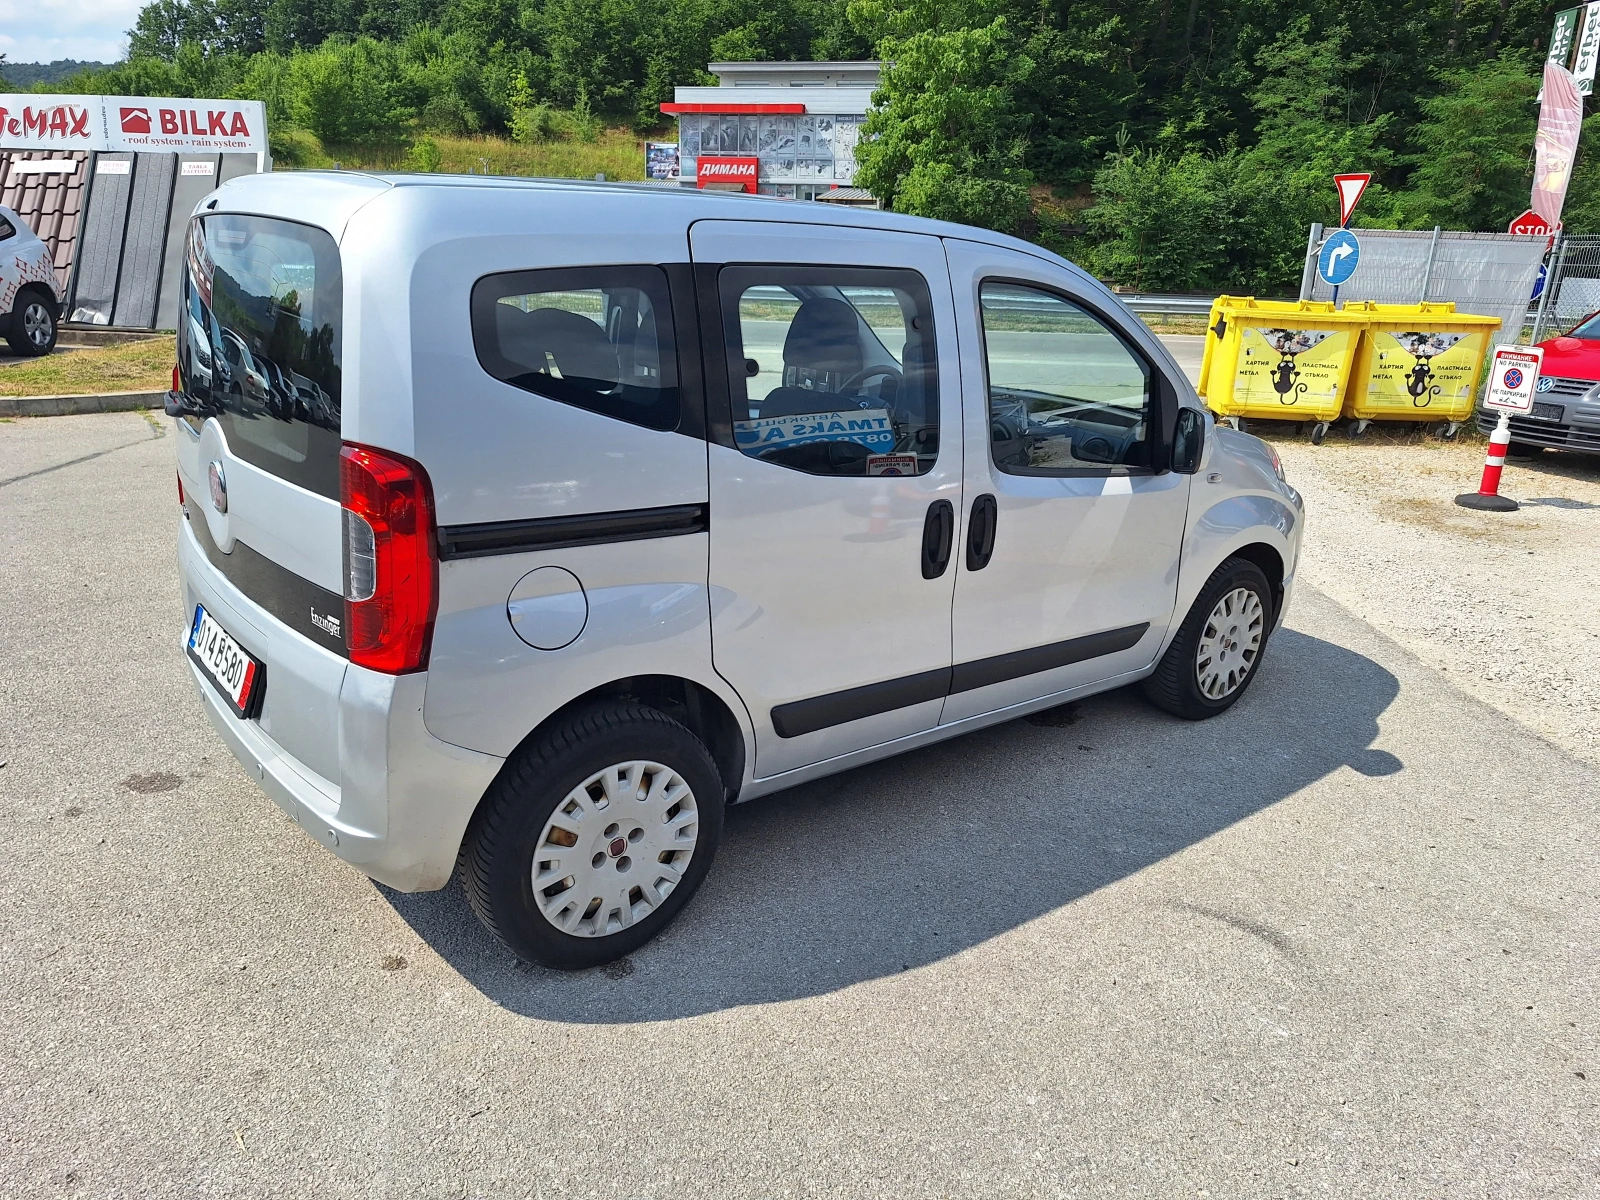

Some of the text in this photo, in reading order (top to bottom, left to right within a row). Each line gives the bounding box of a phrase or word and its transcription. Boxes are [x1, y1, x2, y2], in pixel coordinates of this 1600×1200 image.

[1549, 15, 1568, 64] fbet
[1579, 7, 1600, 72] efbet
[159, 108, 250, 137] BILKA
[128, 136, 247, 148] roof system rain system
[699, 163, 755, 176] ДИМАНА
[1500, 352, 1535, 361] ВНИМАНИЕ!
[1507, 361, 1534, 369] PARKING!
[1499, 389, 1529, 398] ПАРКИРАЙ!
[311, 606, 341, 637] Enzinger
